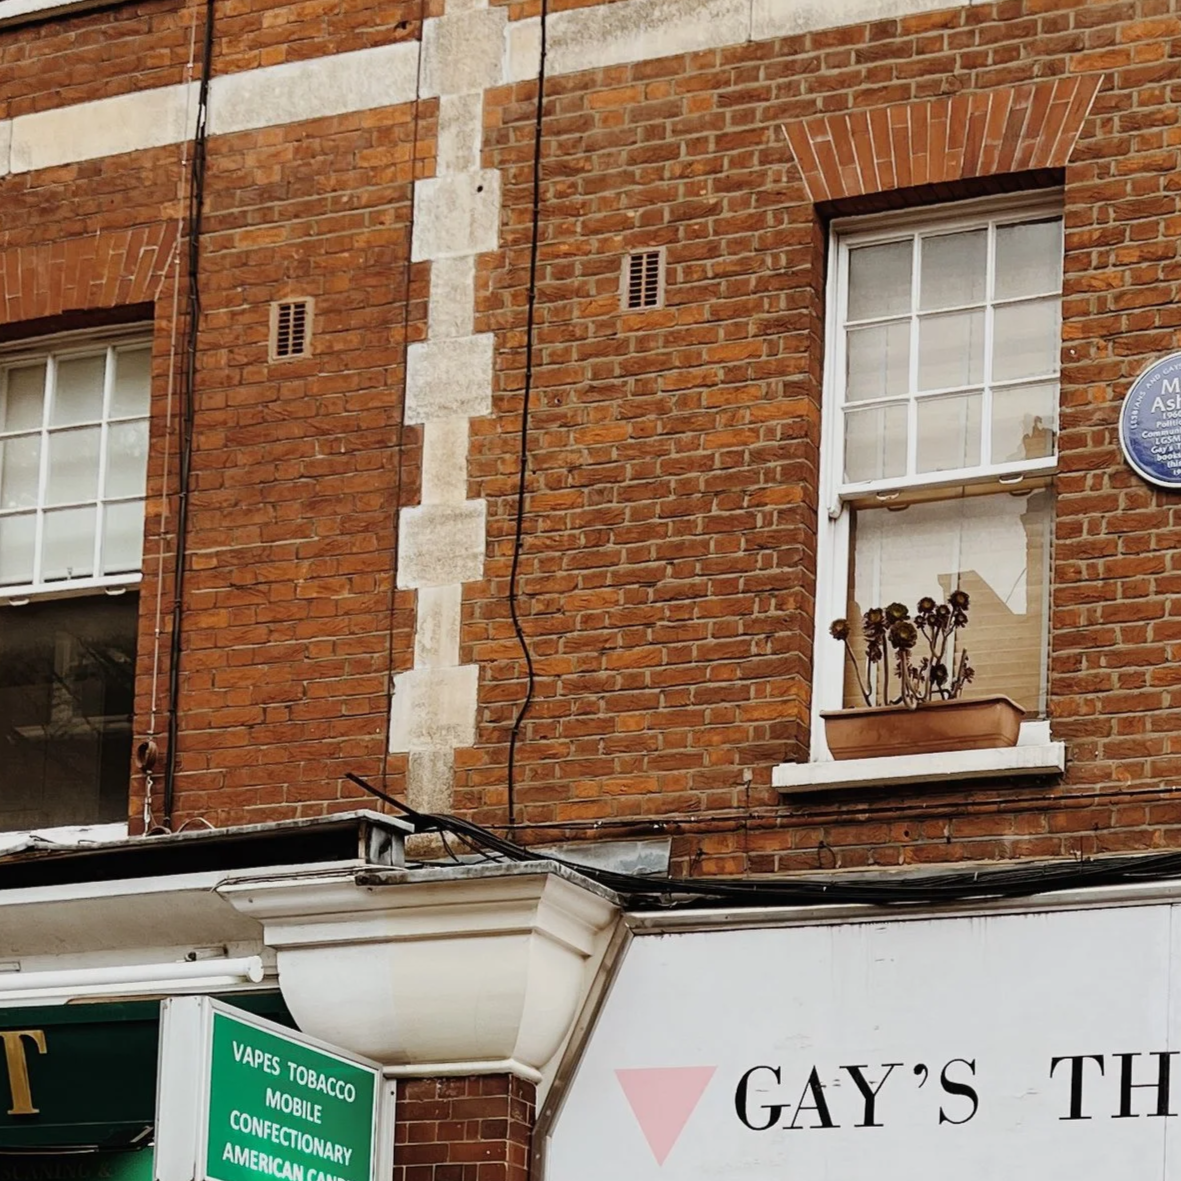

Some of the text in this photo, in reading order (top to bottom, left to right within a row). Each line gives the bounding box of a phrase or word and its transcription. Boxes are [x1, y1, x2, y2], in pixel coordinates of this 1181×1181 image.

[1130, 391, 1146, 430] LESBIANS
[1146, 373, 1161, 389] AND
[1151, 443, 1174, 455] Gay's
[1155, 435, 1181, 445] LGSM
[232, 1040, 357, 1103] VAPES TOBACCO
[735, 1058, 980, 1132] GAY'S
[265, 1087, 323, 1125] MOBILE
[229, 1109, 353, 1167] CONFECTIONARY
